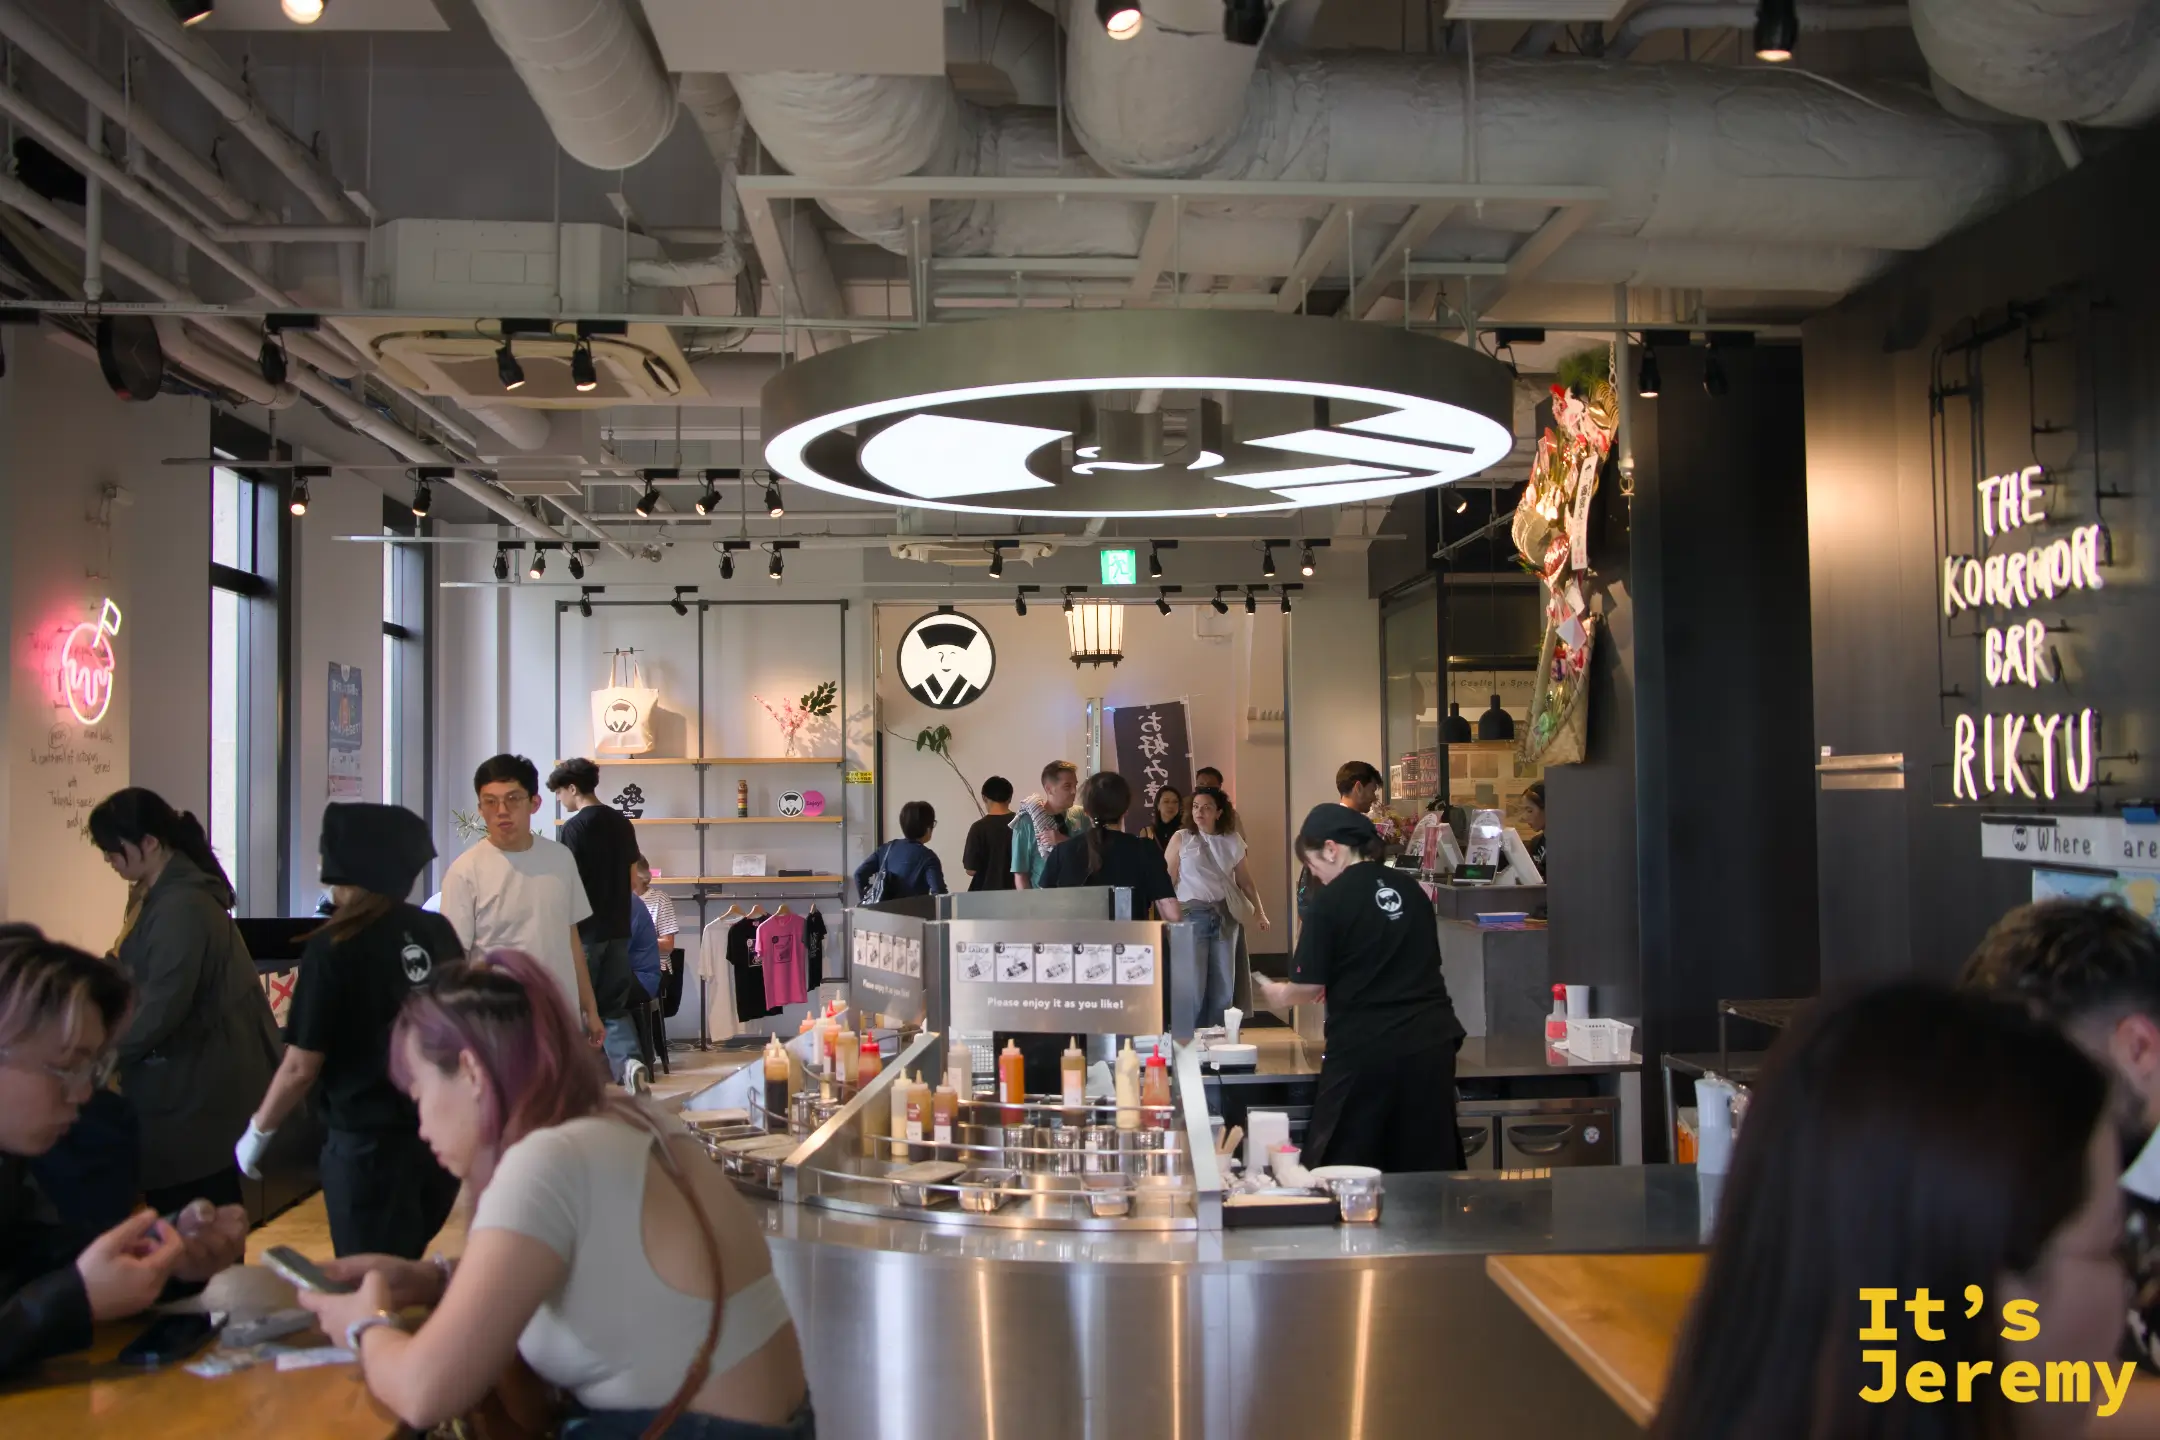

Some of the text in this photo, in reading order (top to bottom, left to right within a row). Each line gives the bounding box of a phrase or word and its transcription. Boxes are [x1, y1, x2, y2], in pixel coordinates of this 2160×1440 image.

[1978, 465, 2045, 536] THE
[1944, 523, 2103, 617] KONAMON
[1510, 679, 1535, 689] Spec
[1986, 618, 2055, 688] BAR
[1953, 708, 2093, 800] RIKYU
[2037, 827, 2159, 858] Where are
[987, 997, 1124, 1011] Please enjoy it as you like!
